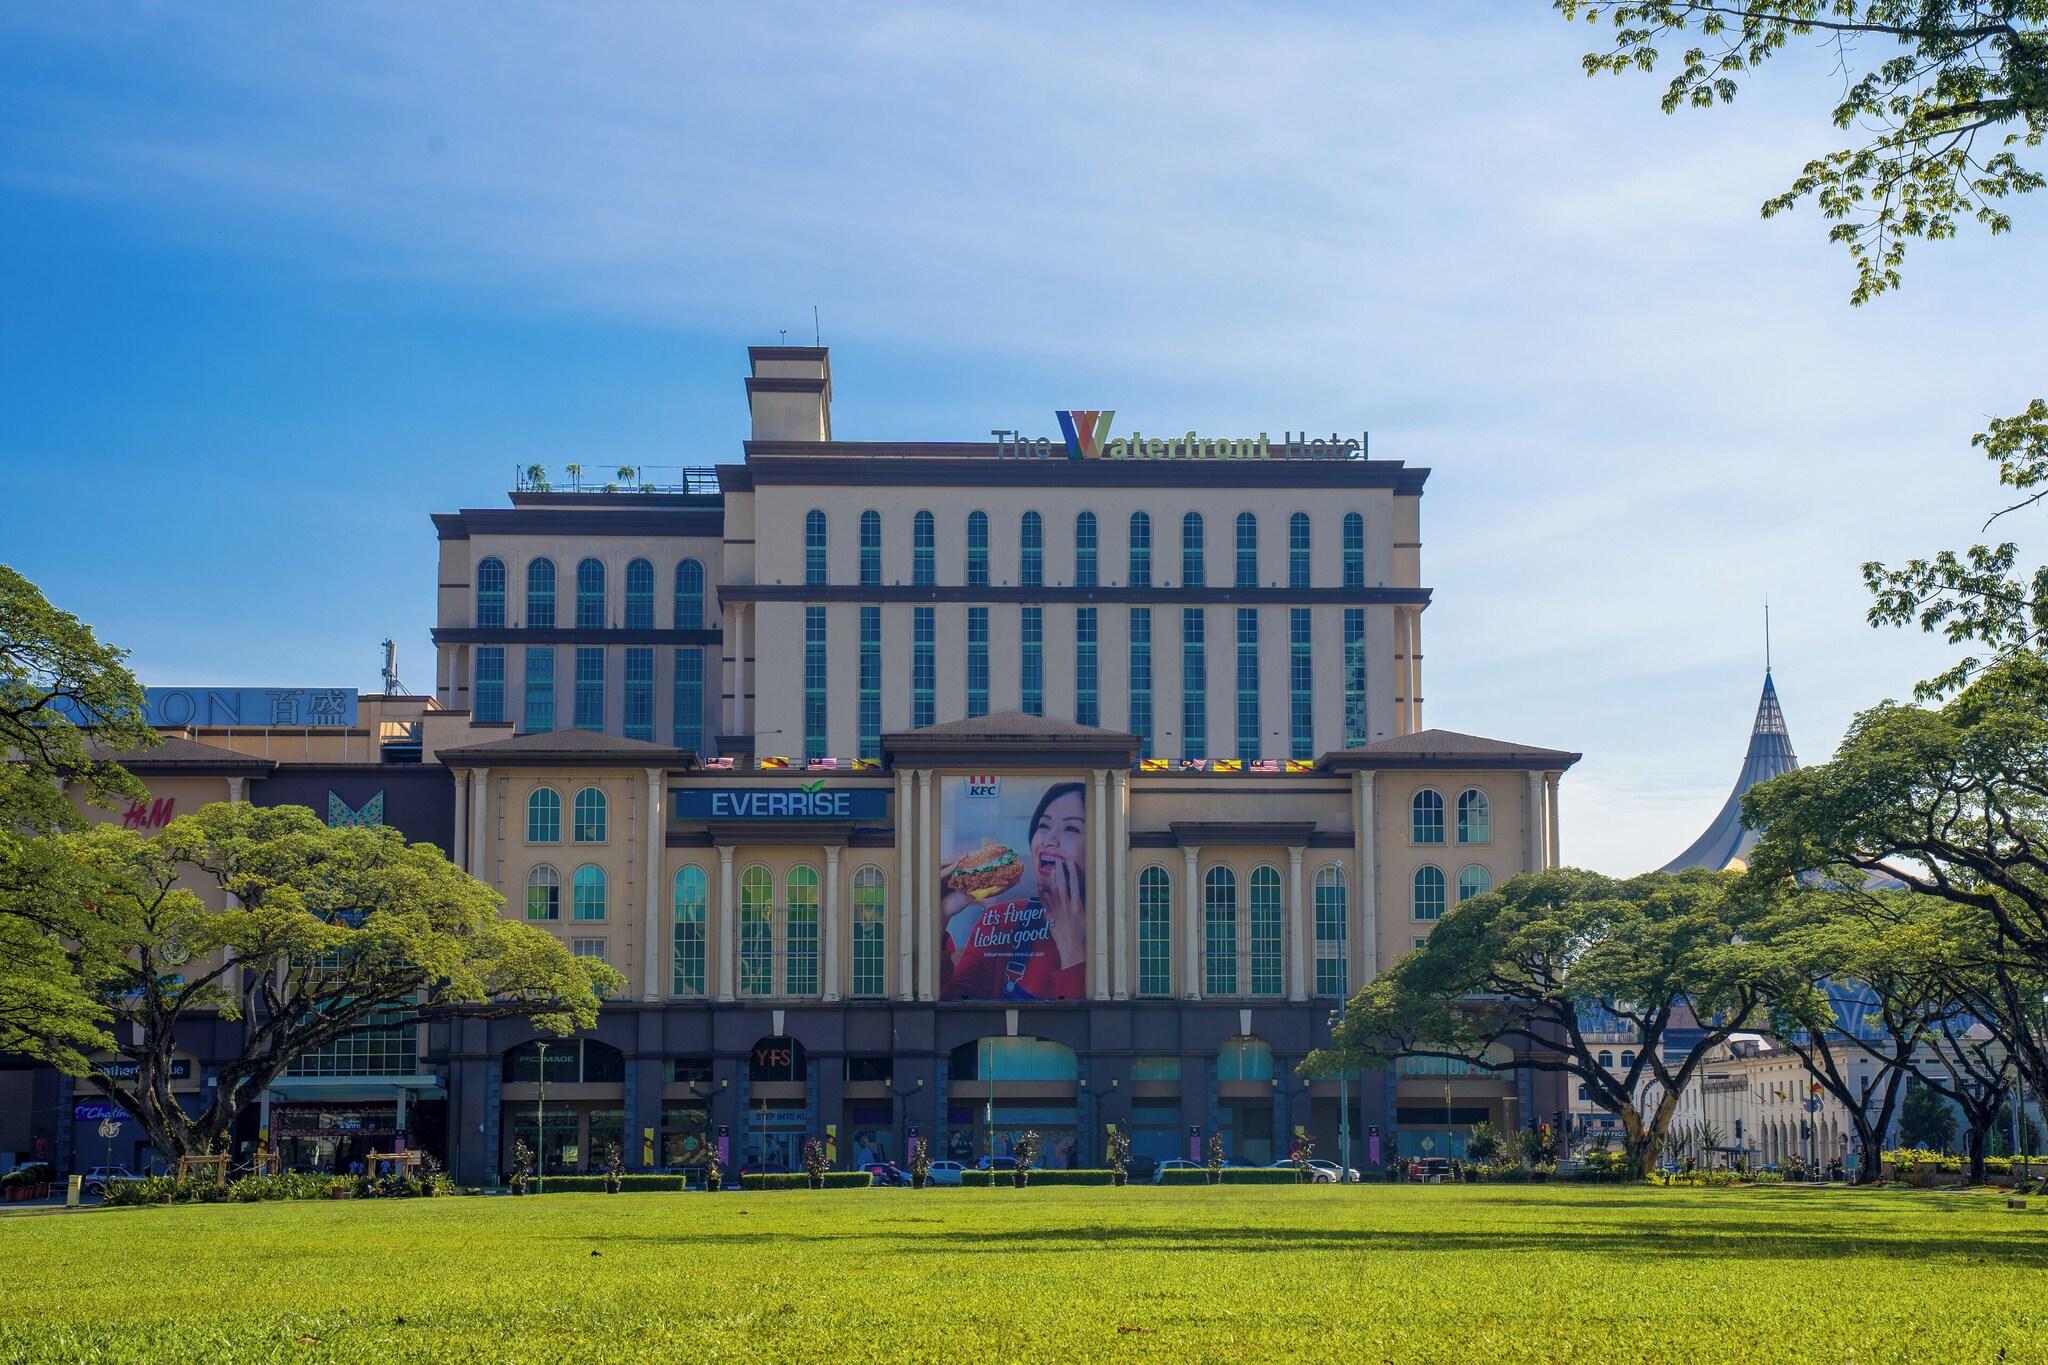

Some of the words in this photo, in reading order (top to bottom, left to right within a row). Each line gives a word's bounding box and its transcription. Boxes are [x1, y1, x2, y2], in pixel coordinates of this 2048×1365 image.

[991, 429, 1052, 460] The
[1055, 410, 1270, 461] Waterfront
[1285, 431, 1369, 460] Hotel
[265, 690, 348, 728] 百盛
[711, 792, 850, 816] EVERRISE
[970, 785, 996, 796] KFC
[122, 798, 176, 830] H&M
[1003, 902, 1047, 928] finger
